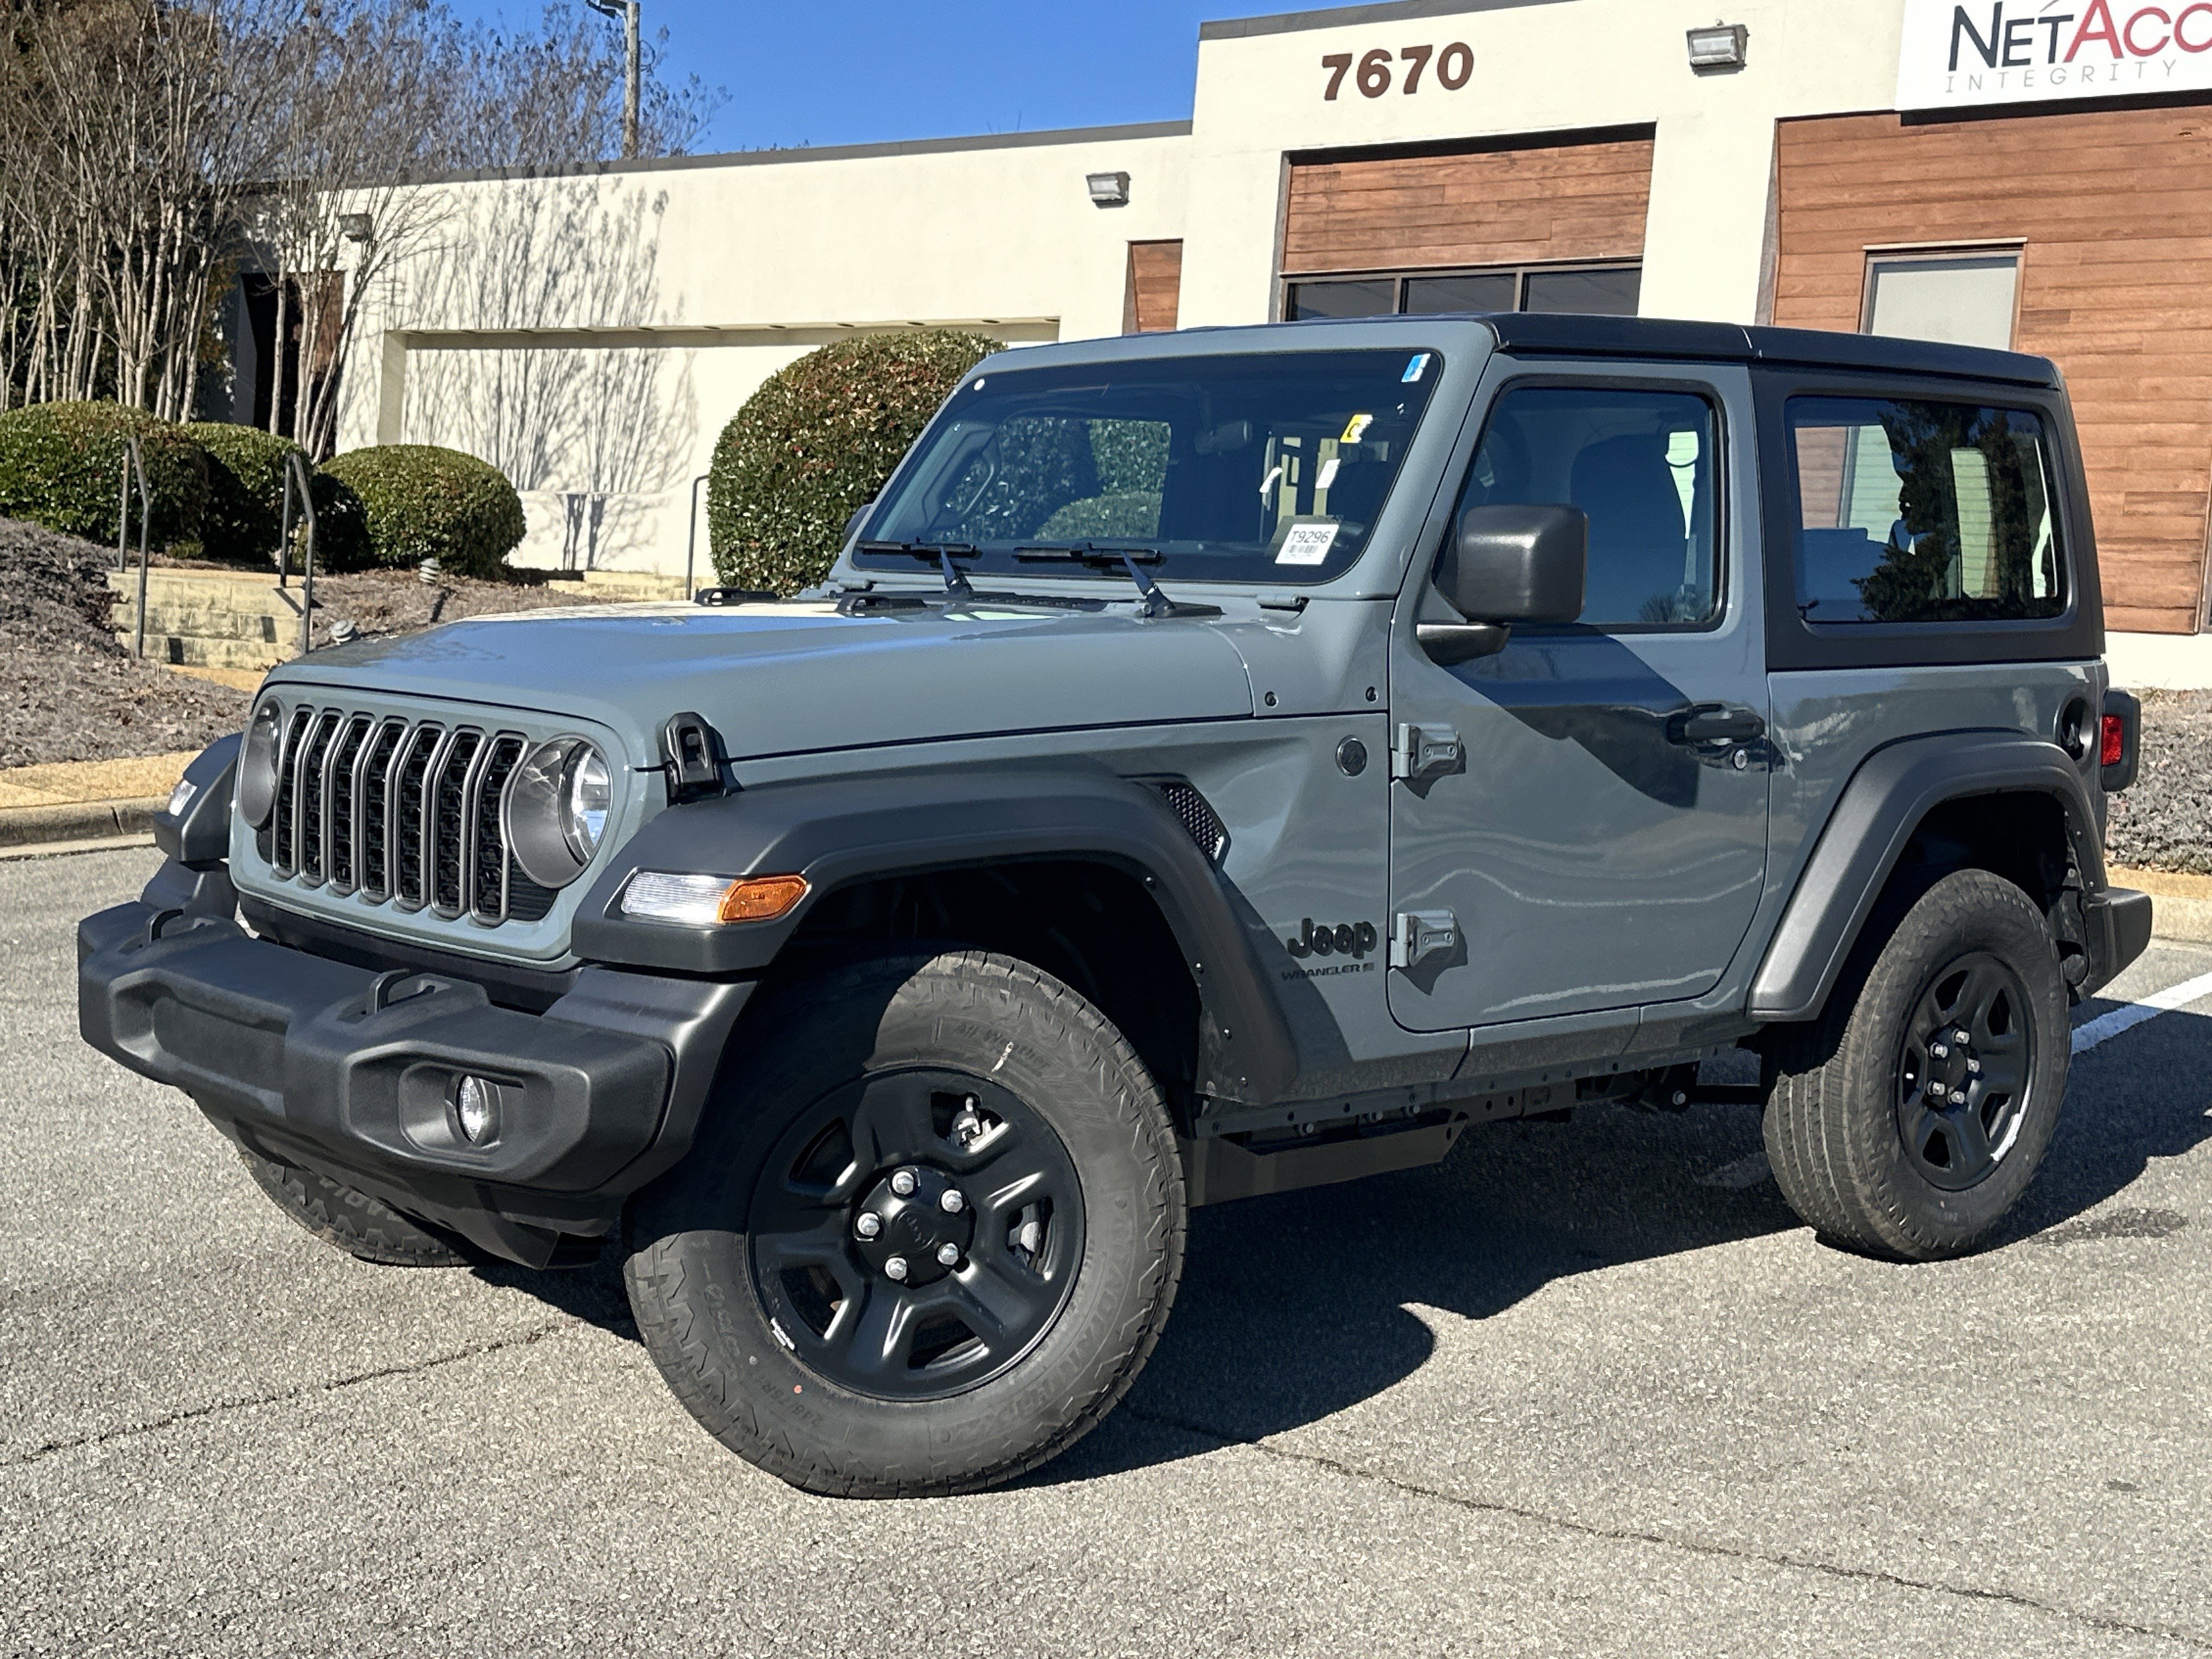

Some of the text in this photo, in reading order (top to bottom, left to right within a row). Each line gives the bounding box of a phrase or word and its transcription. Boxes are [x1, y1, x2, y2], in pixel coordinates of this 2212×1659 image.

[1322, 42, 1474, 100] 7670
[1945, 59, 2176, 93] INTEGRITY
[1291, 531, 1331, 543] T9296
[1287, 917, 1377, 960] Jeep
[1281, 964, 1360, 980] WRANGLER
